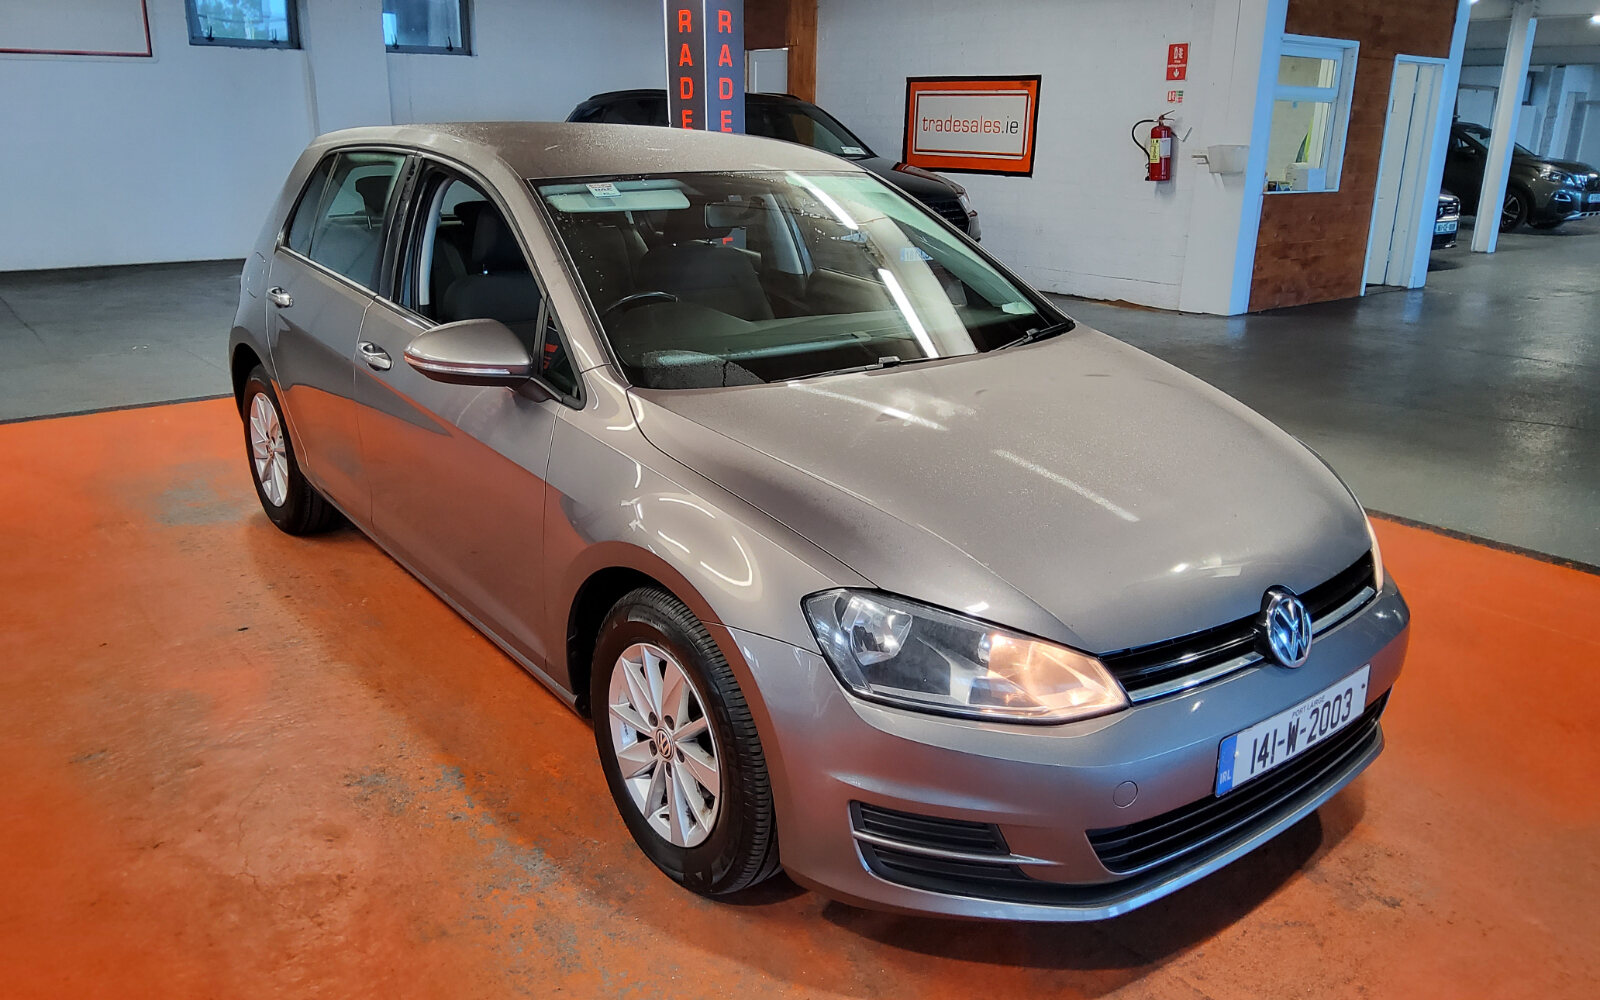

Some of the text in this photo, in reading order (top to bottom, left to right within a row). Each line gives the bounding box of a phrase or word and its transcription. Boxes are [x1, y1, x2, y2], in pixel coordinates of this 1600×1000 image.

[922, 115, 1019, 134] tradesales.ie
[1250, 688, 1353, 775] 141-W-2003
[1219, 769, 1232, 785] IRL
